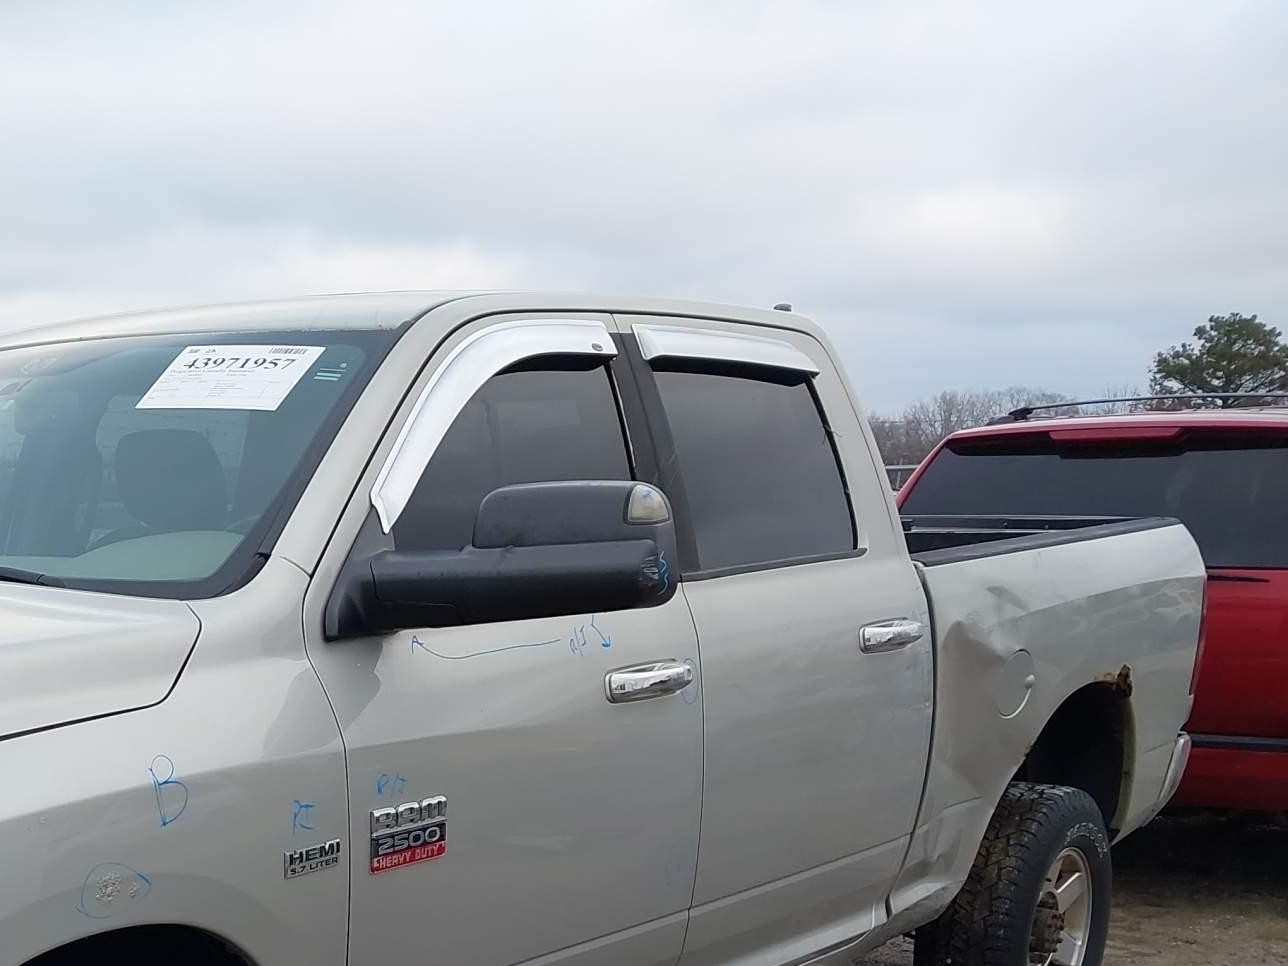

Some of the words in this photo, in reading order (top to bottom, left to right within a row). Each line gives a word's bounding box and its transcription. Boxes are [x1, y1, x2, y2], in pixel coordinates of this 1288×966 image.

[183, 357, 297, 370] 43971957
[288, 840, 341, 866] HEMI
[378, 826, 441, 855] 2500
[290, 865, 306, 876] 5.7
[309, 856, 339, 871] LITER
[378, 851, 412, 869] HEAVY
[415, 844, 440, 861] DUTY
